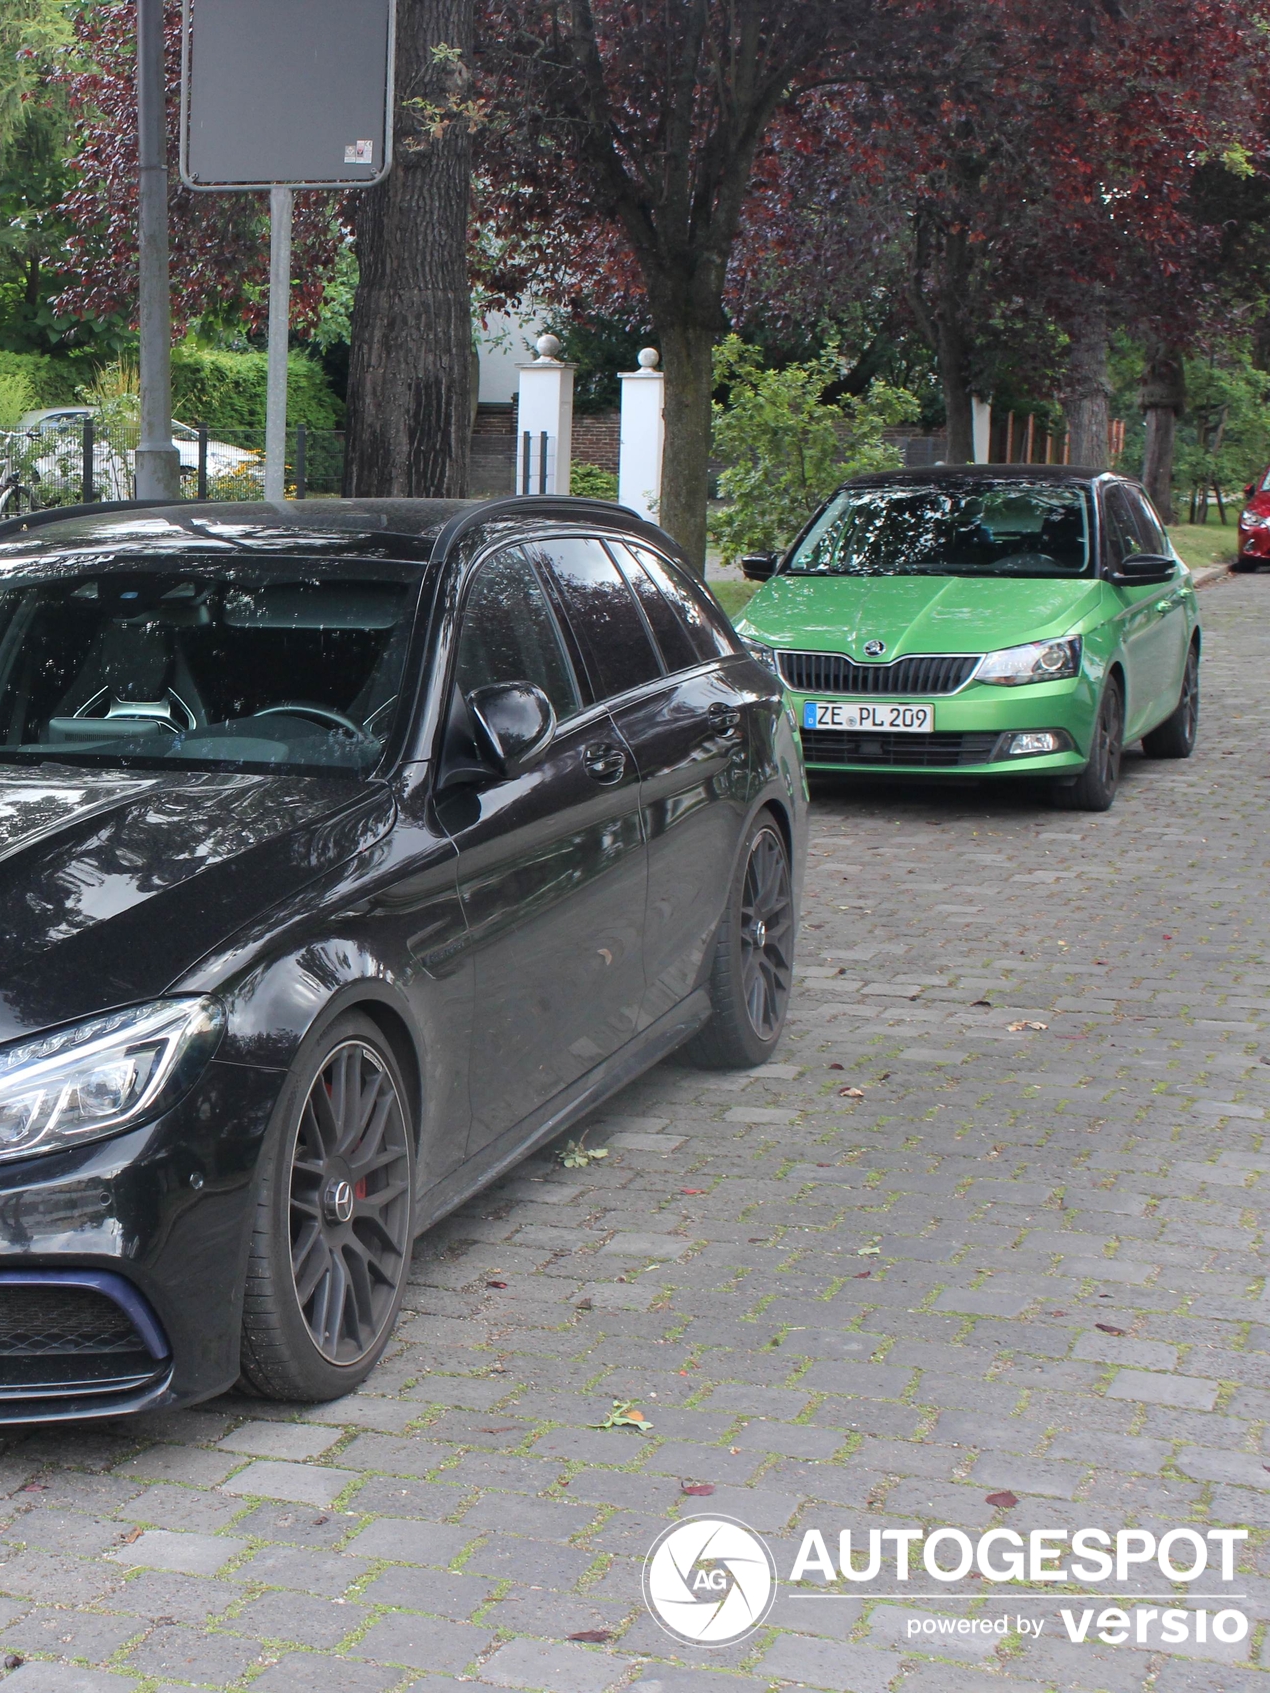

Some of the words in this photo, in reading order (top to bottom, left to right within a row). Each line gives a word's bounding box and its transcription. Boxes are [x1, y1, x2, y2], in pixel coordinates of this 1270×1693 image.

[817, 706, 843, 725] ZE
[859, 707, 884, 726] PL
[889, 707, 928, 728] 209
